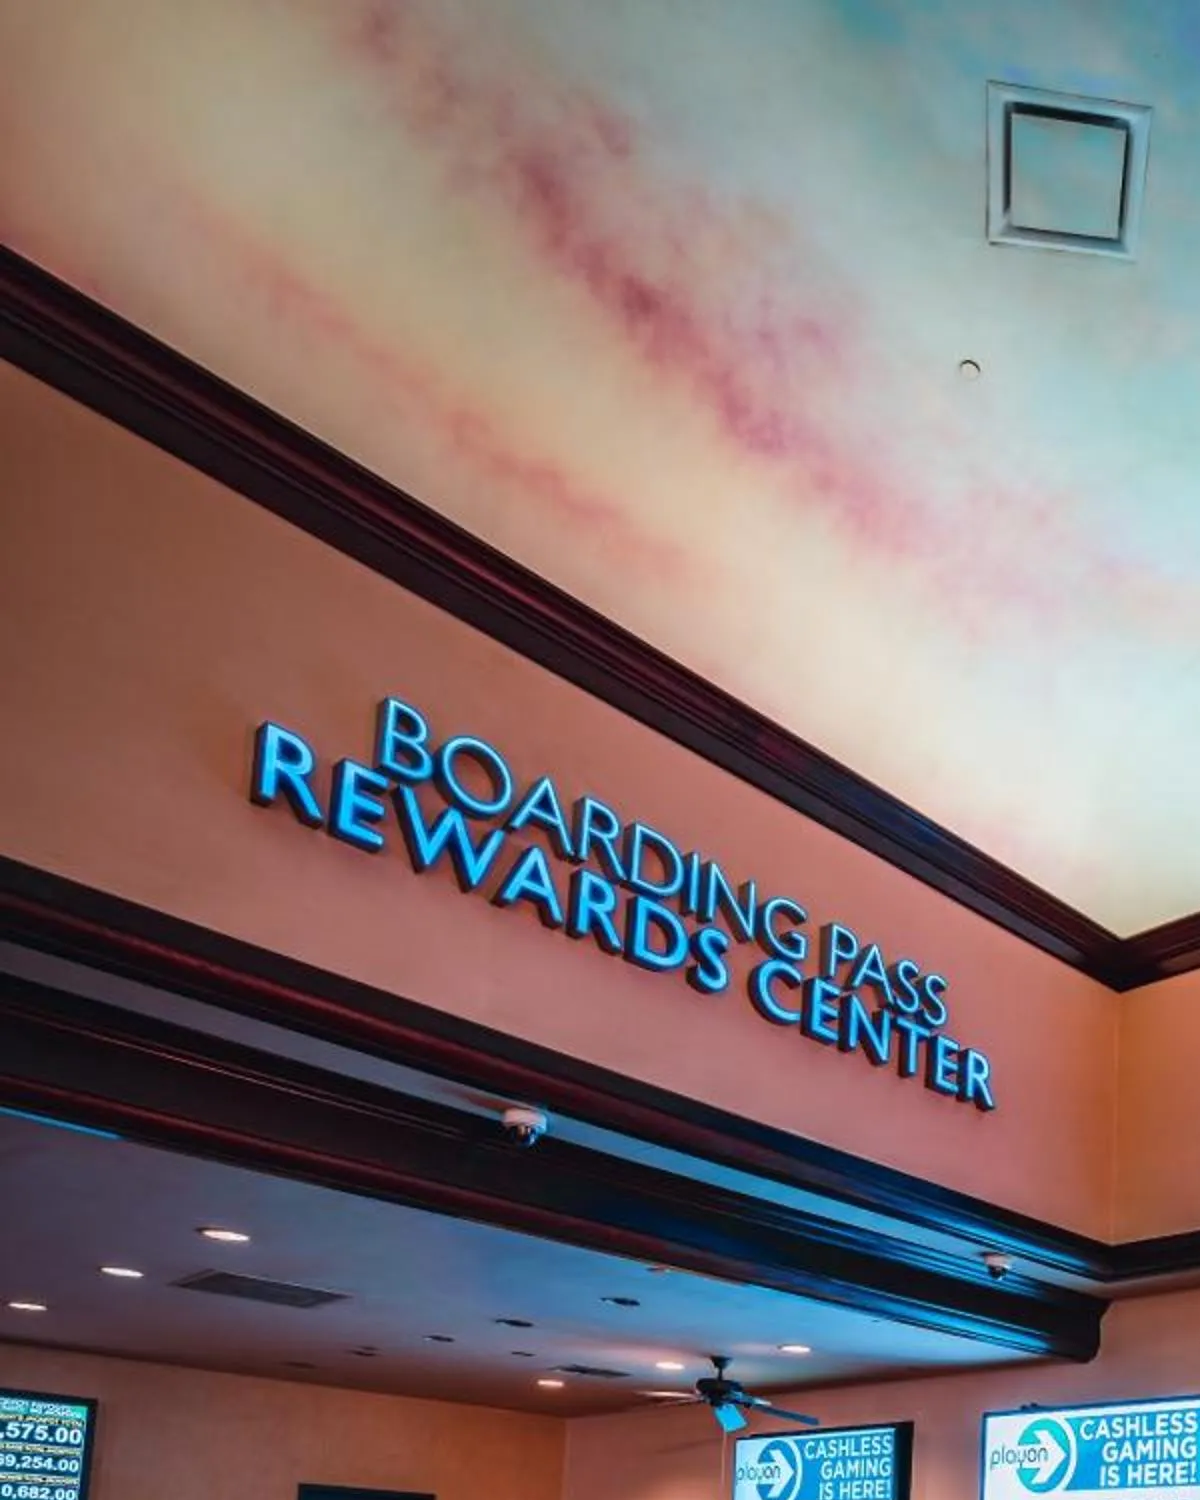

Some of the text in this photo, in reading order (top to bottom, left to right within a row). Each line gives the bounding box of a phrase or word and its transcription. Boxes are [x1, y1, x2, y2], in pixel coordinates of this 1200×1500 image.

[374, 695, 949, 1028] BOARDING PASS
[250, 719, 997, 1111] REWARDS CENTER
[1079, 1411, 1199, 1441] CASHLESS
[804, 1434, 894, 1461] CASHLESS
[989, 1443, 1050, 1471] playon
[1101, 1436, 1198, 1463] GAMING
[820, 1457, 892, 1481] GAMING
[1100, 1461, 1197, 1488] IS HERE!
[839, 1478, 892, 1500] HERE!
